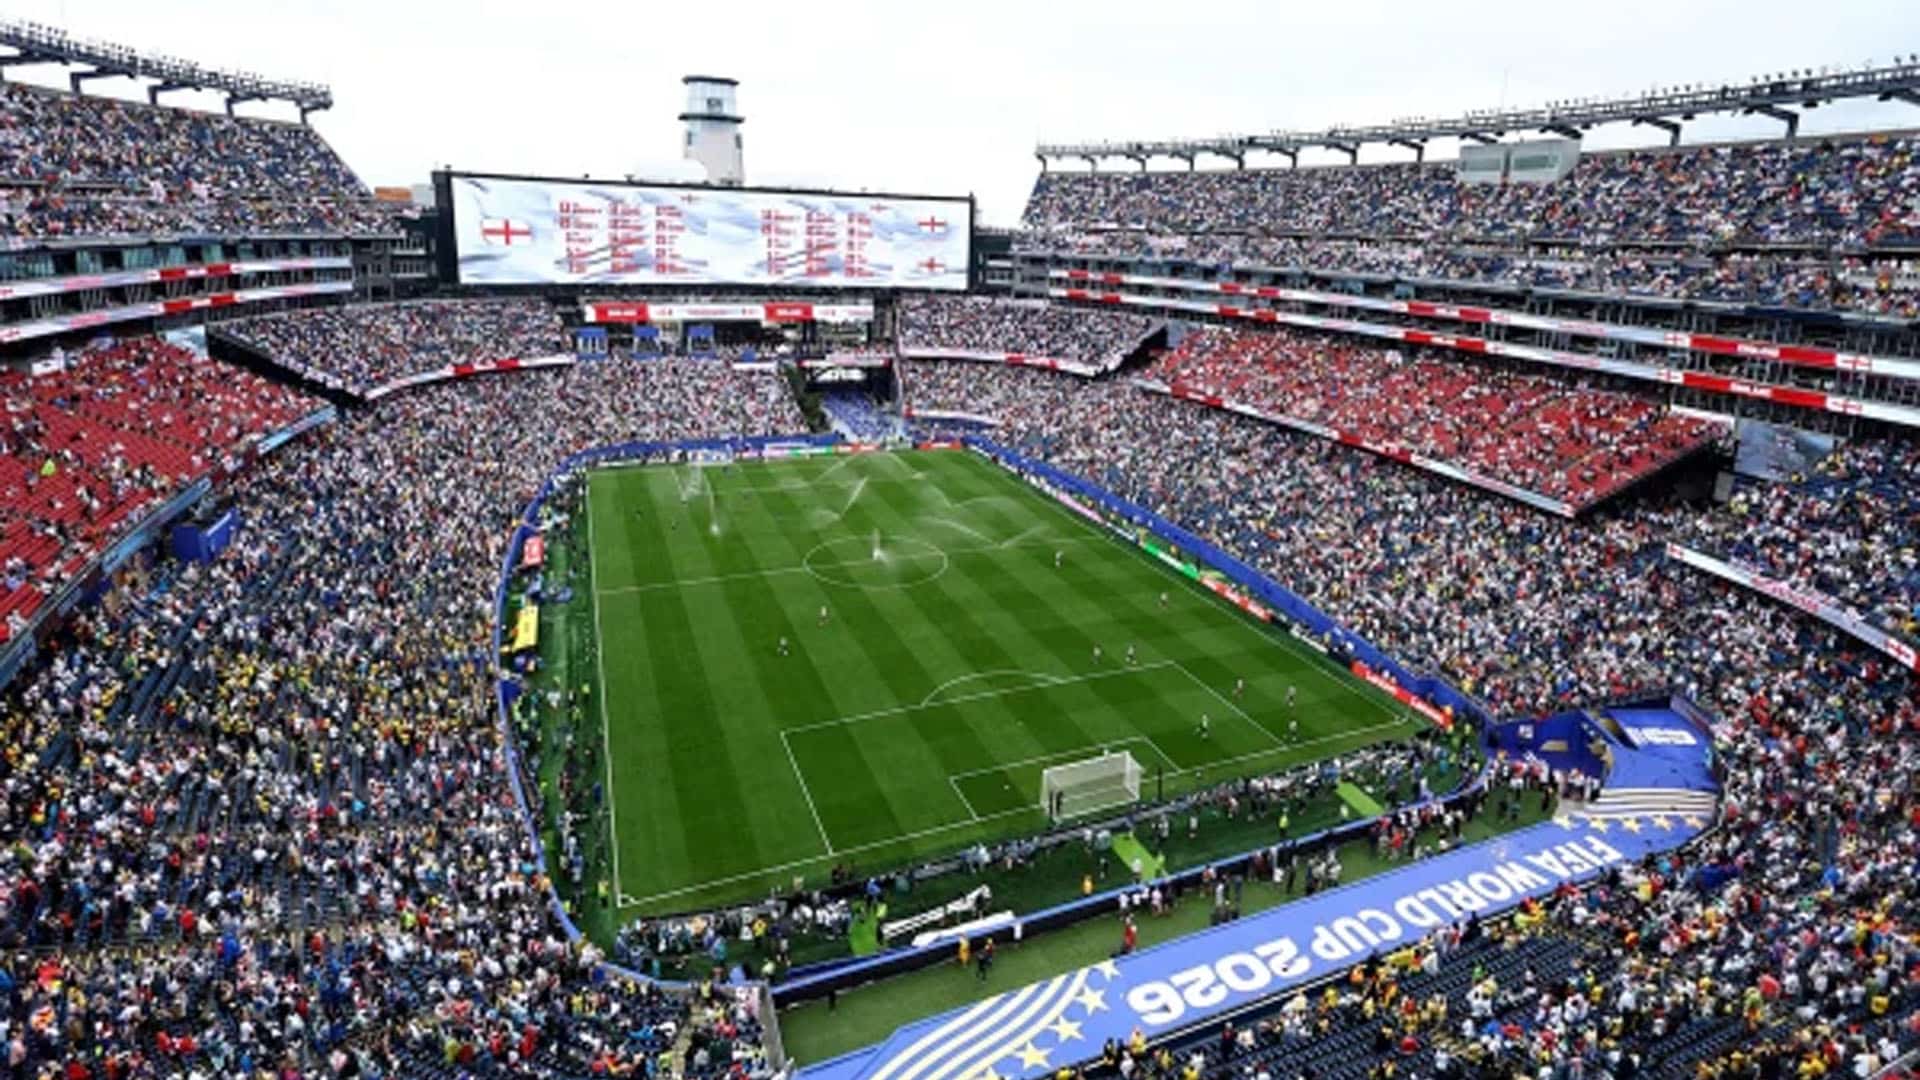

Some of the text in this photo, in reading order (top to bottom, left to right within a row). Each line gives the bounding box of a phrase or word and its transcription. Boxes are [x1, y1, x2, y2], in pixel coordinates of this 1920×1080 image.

[1127, 836, 1622, 1025] FIFA WORLD CUP 2026
